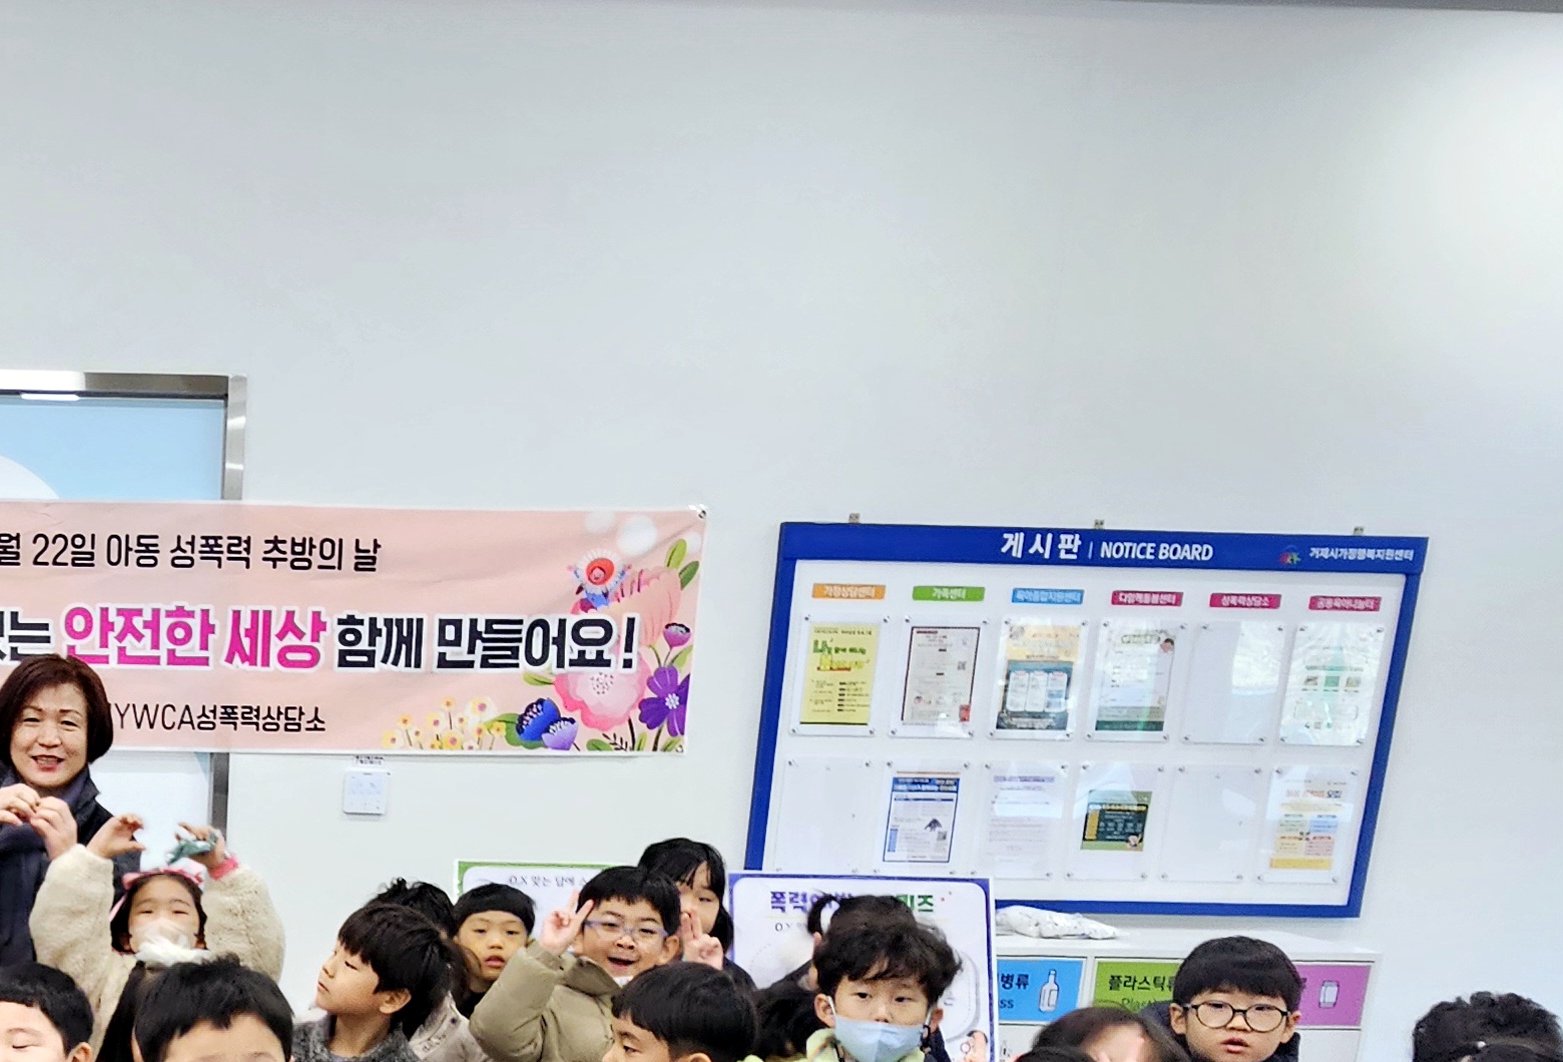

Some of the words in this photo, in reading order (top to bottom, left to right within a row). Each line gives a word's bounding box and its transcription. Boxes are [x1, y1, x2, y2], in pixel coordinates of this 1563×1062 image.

[32, 534, 96, 568] 22일
[106, 534, 160, 569] 아동
[170, 535, 252, 570] 성폭력
[262, 535, 344, 571] 추방의
[355, 538, 381, 573] 날
[1001, 532, 1082, 560] 게시판
[1100, 541, 1158, 560] NOTICE
[1159, 543, 1214, 562] BOARD
[64, 604, 216, 667] 안전한
[225, 606, 326, 669] 세상
[337, 614, 424, 669] 함께
[437, 617, 634, 670] 만들어요!
[109, 703, 326, 732] YWCA성폭력상담소
[999, 973, 1029, 990] 병류
